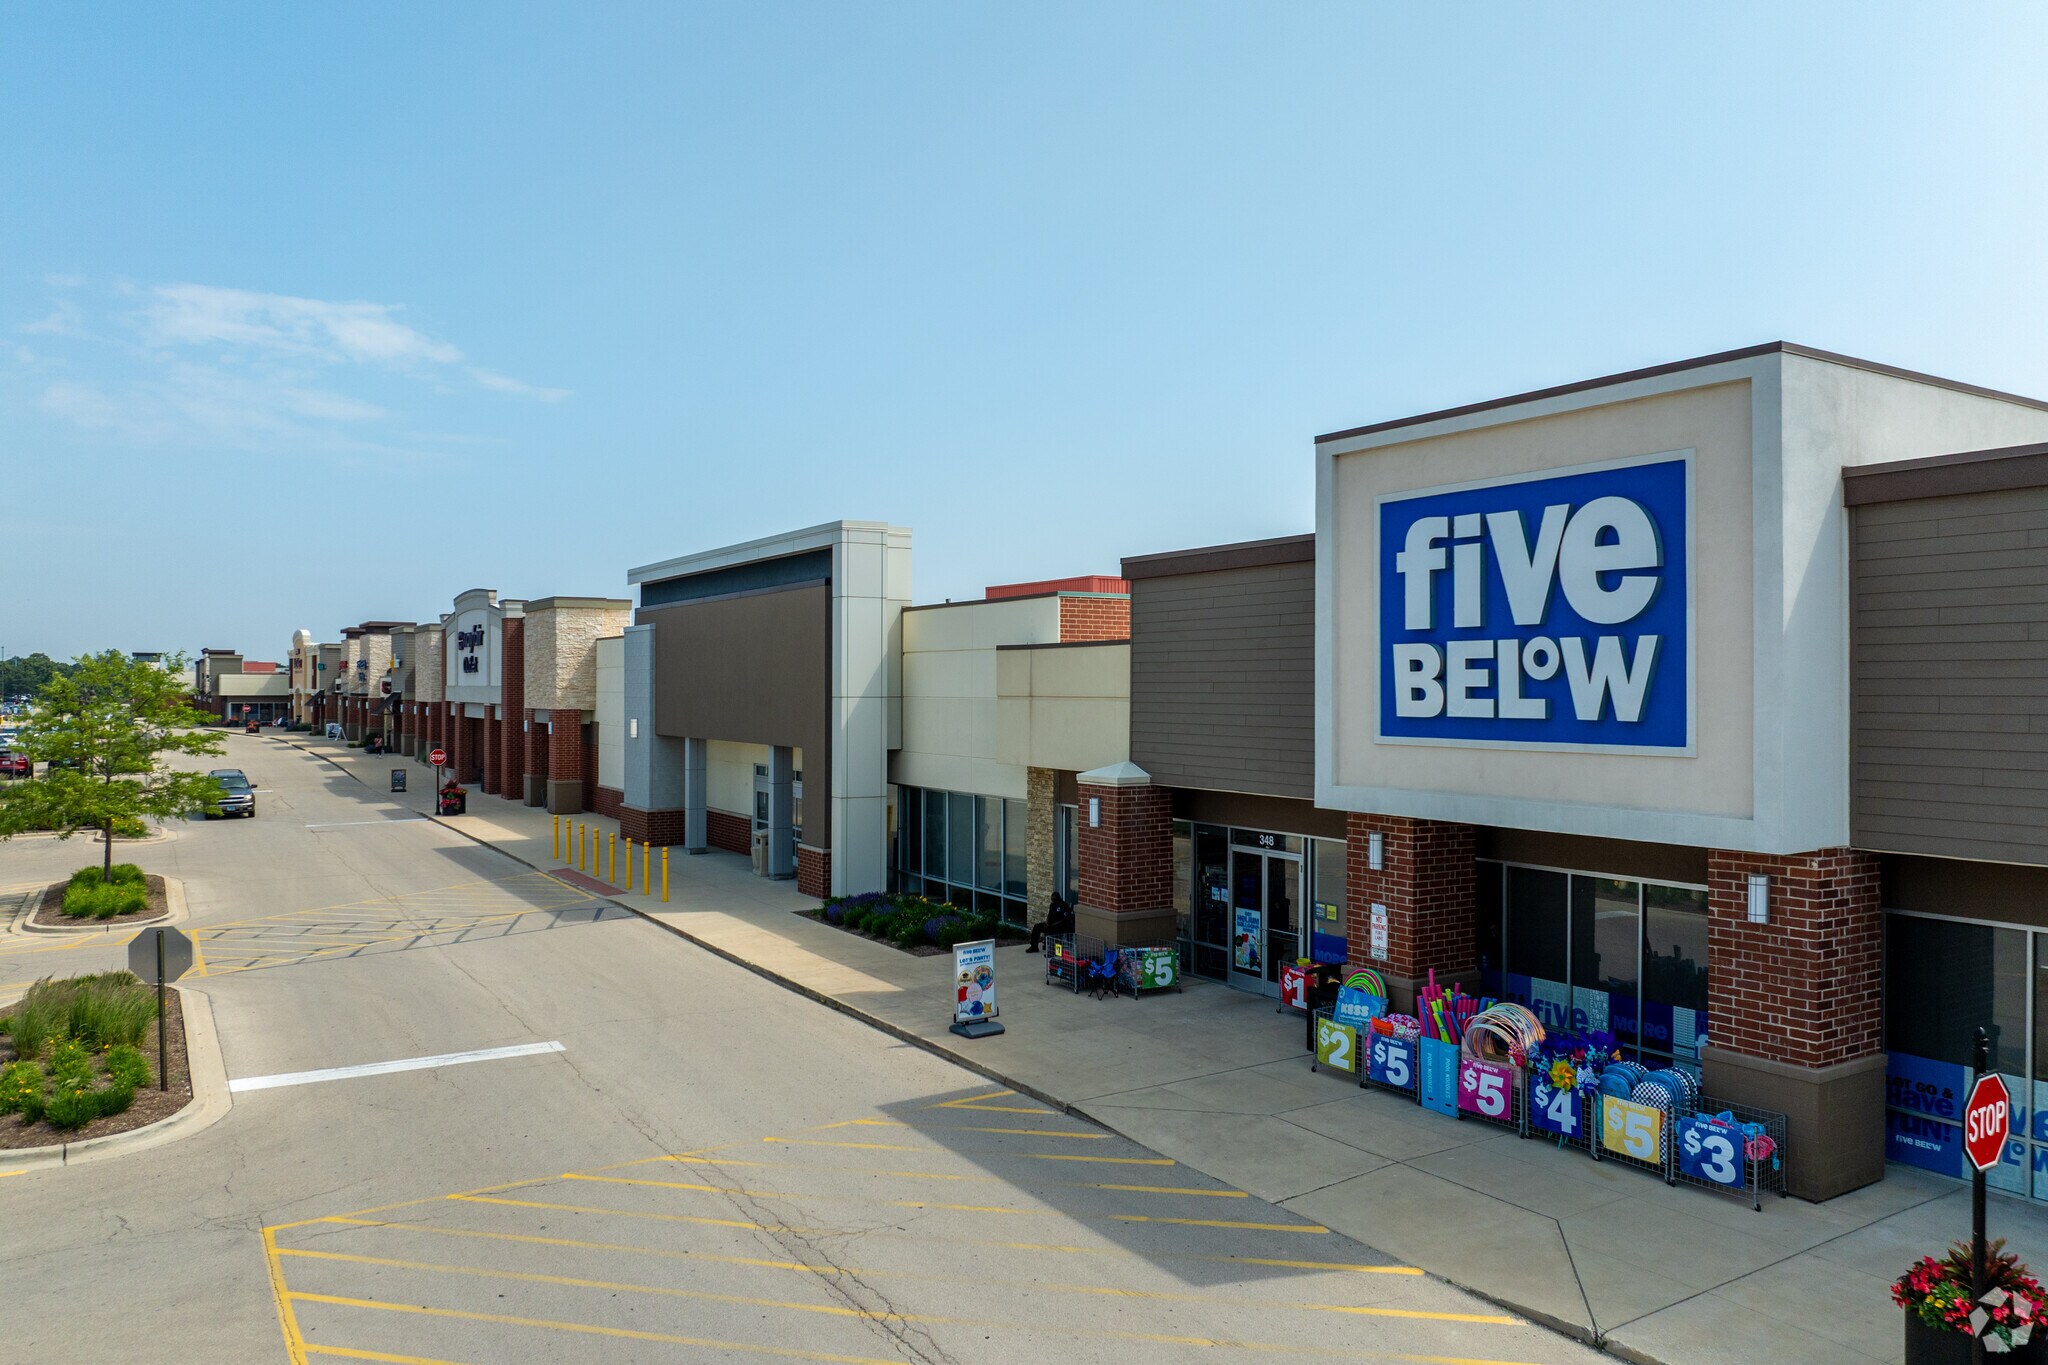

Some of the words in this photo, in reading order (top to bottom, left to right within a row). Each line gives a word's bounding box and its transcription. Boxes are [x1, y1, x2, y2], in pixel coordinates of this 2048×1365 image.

[1396, 496, 1663, 630] five
[1393, 635, 1662, 722] BELOW
[1259, 834, 1274, 846] 348
[1145, 956, 1173, 986] $5
[1284, 972, 1307, 1010] $1
[1320, 1025, 1349, 1070] $2
[1374, 1041, 1409, 1086] $5
[1463, 1067, 1504, 1116] $5
[1535, 1083, 1577, 1134] $4
[1915, 1082, 1938, 1096] GO
[1608, 1105, 1654, 1159] $5
[1896, 1134, 1914, 1145] five
[1914, 1139, 1942, 1152] BELOW
[1969, 1100, 2006, 1143] STOP
[1684, 1127, 1736, 1184] $3
